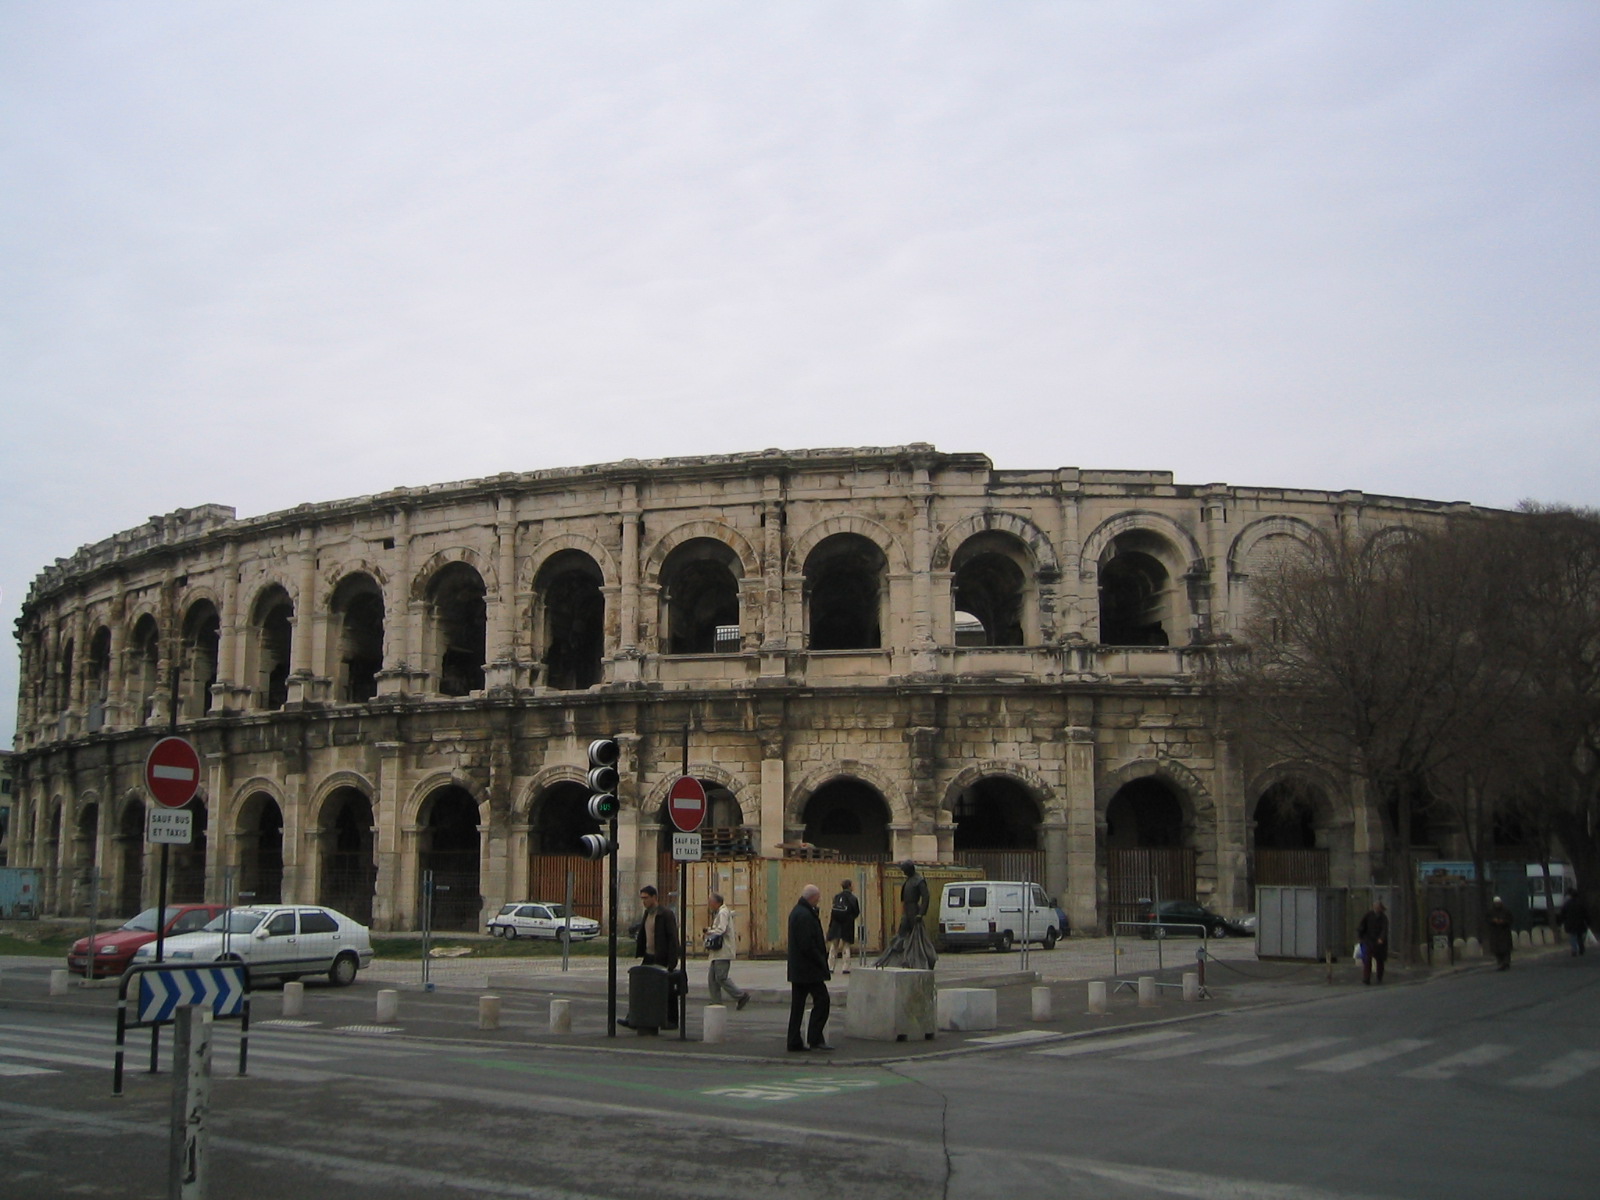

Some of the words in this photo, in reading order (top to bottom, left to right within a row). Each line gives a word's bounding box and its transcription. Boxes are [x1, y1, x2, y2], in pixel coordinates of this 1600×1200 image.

[152, 814, 172, 823] SAUF
[175, 816, 190, 824] BUS
[153, 828, 162, 836] ET
[166, 828, 187, 837] TAXIS
[699, 1077, 880, 1101] BUS
